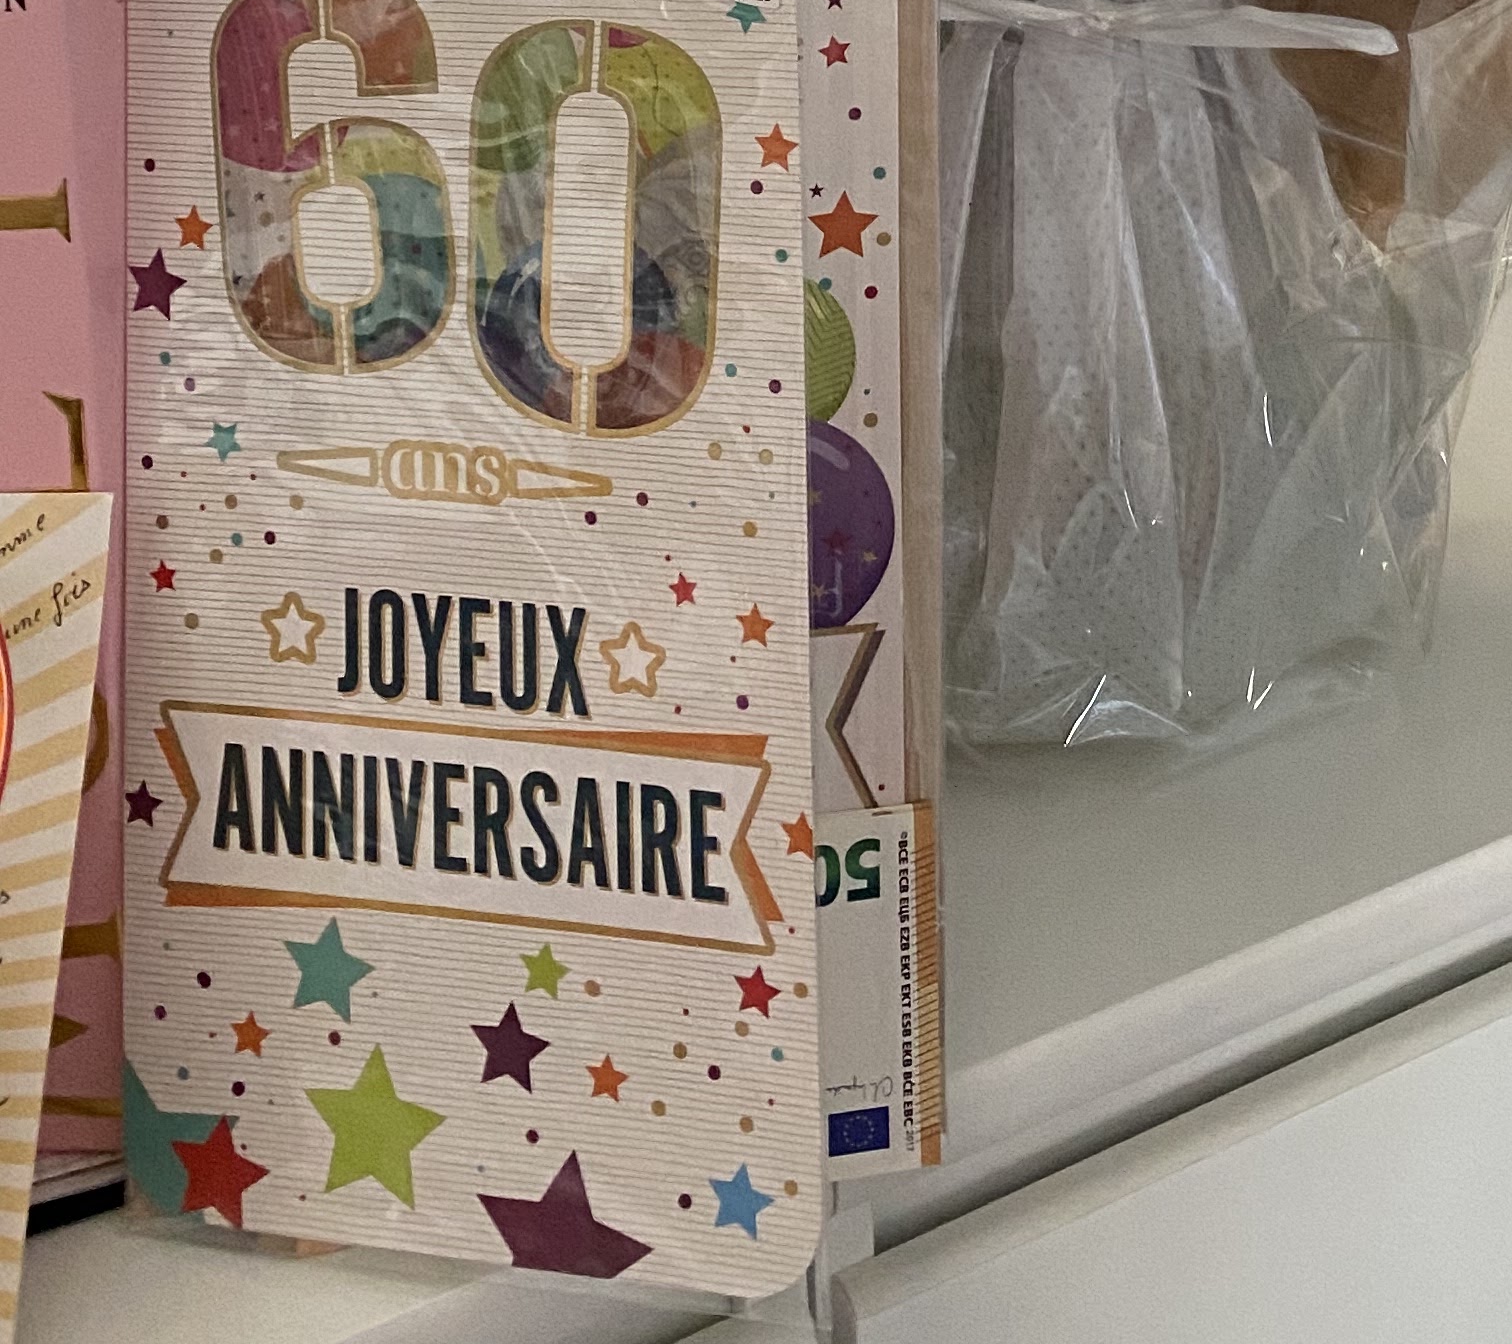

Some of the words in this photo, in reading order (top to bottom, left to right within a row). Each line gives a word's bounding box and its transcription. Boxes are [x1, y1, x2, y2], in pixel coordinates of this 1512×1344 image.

[389, 448, 500, 497] ans
[337, 587, 591, 718] JOYEUX
[212, 742, 731, 904] ANNIVERSAIRE
[815, 838, 881, 908] 50
[899, 868, 909, 893] ECB
